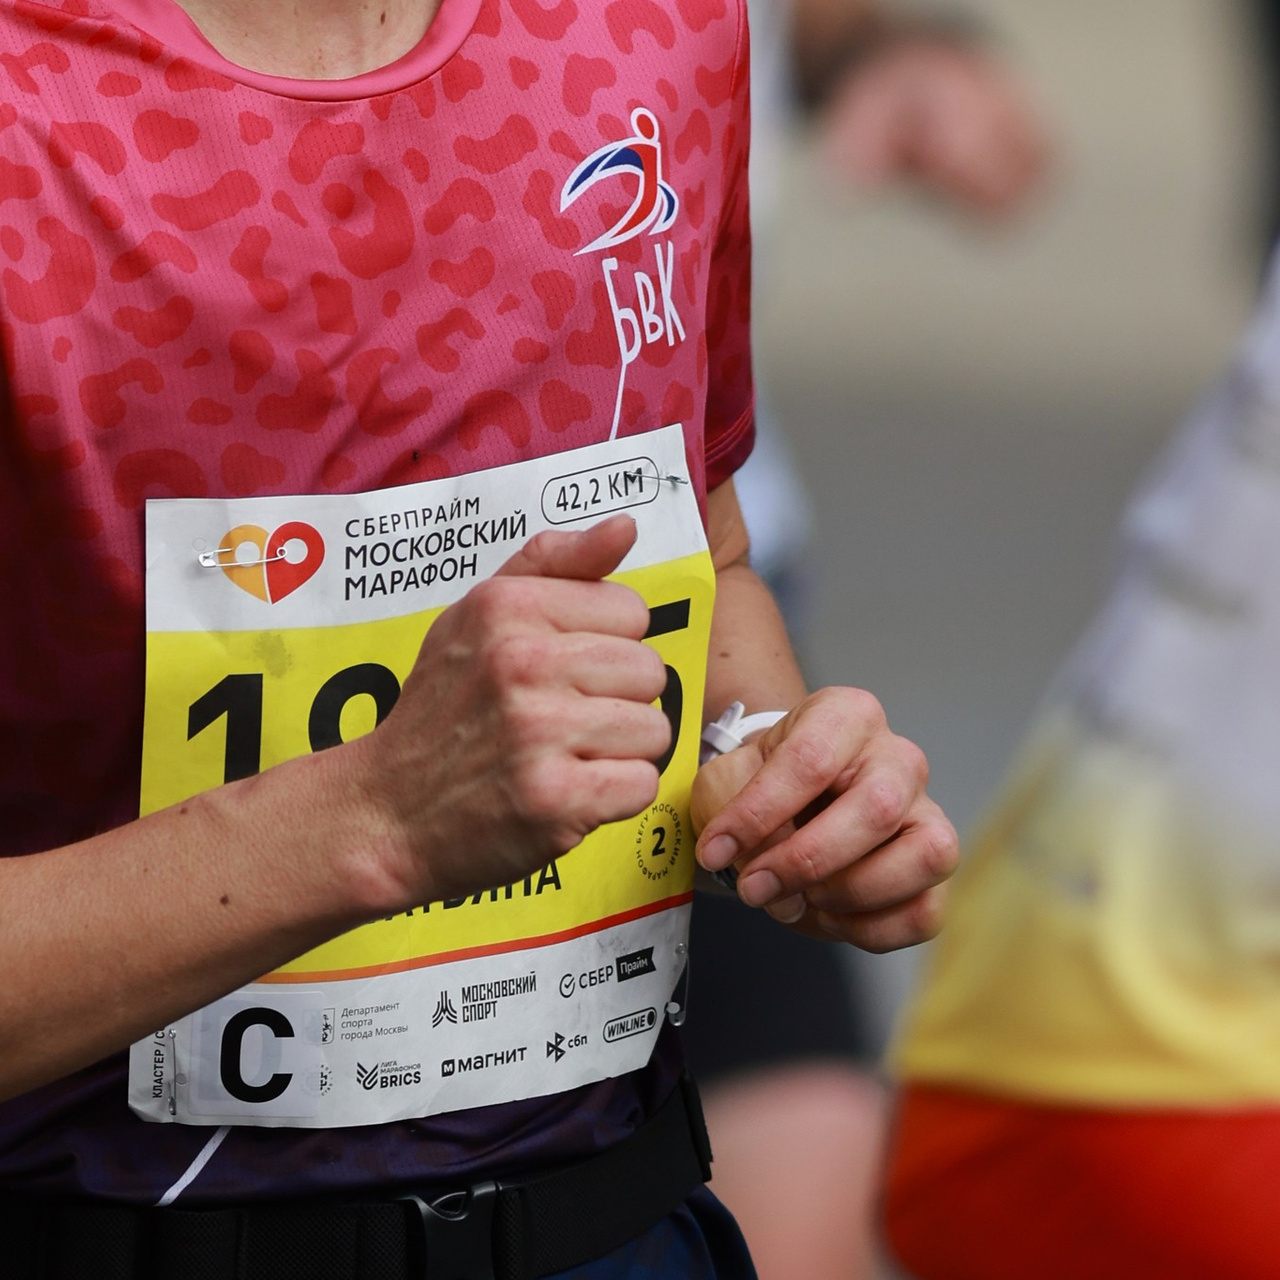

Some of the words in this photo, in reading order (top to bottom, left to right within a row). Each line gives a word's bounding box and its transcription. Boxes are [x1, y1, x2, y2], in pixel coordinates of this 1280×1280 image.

[556, 478, 601, 512] 42,2
[608, 467, 644, 500] КМ
[345, 497, 480, 538] СБЕРПРАЙМ
[345, 509, 527, 570] МОСКОВСКИЙ
[345, 553, 478, 601] МАРАФОН
[652, 826, 666, 857] 2
[461, 971, 537, 1004] МОСКОВСКИЙ
[579, 965, 613, 989] СБЕР
[620, 956, 648, 975] Прайм
[341, 1002, 400, 1019] Департамент
[341, 1019, 373, 1030] спорта
[462, 1000, 498, 1023] СПОРТ
[607, 1014, 646, 1038] WINLINE
[340, 1030, 373, 1041] города
[375, 1025, 408, 1037] Москвы
[152, 1049, 164, 1099] КЛАСТЕР
[380, 1071, 421, 1089] BRICS
